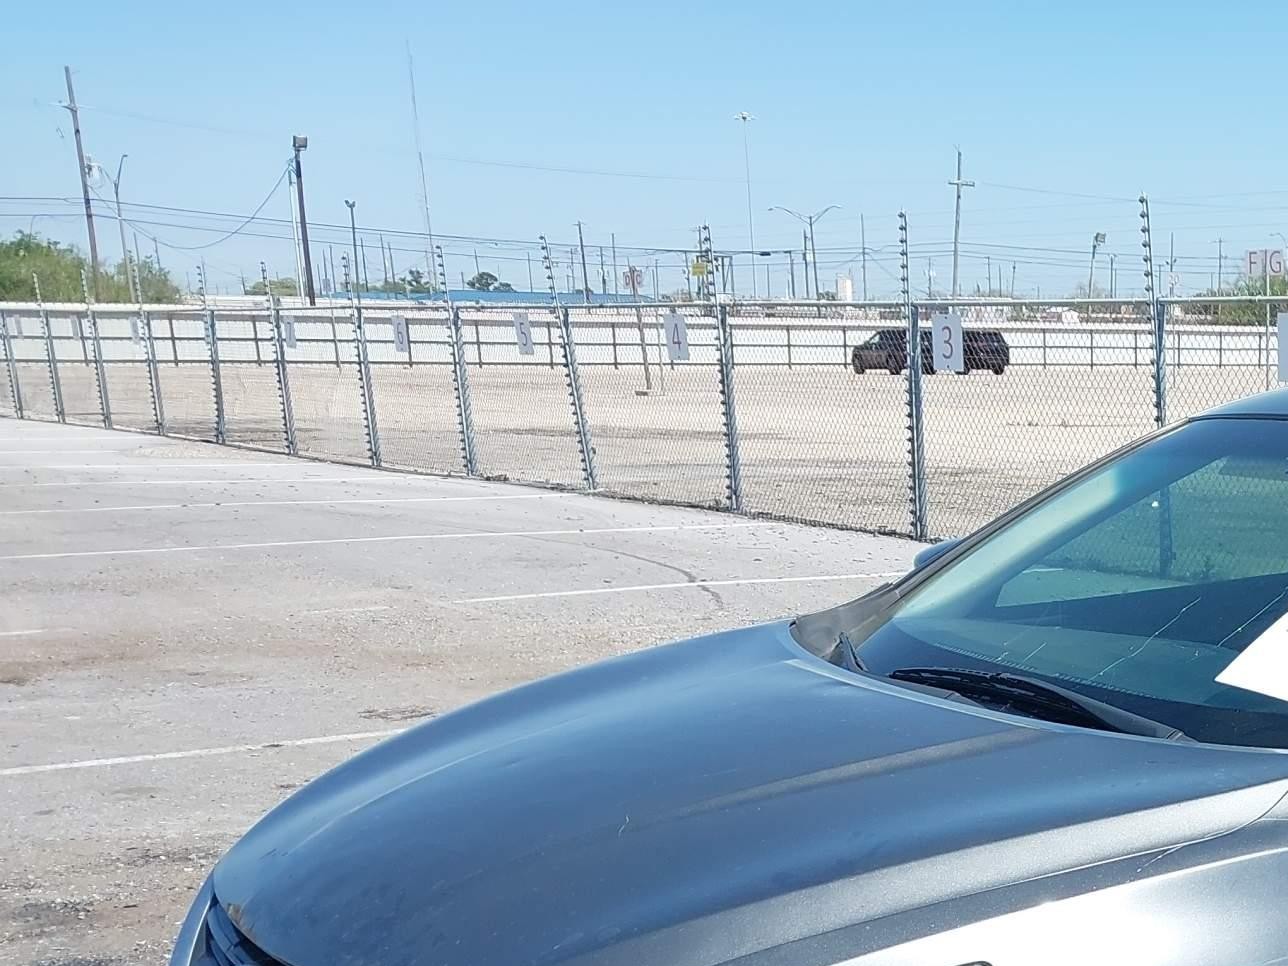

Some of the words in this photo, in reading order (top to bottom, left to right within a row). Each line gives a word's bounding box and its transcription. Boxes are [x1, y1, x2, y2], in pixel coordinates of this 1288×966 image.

[396, 322, 405, 345] 6
[519, 323, 528, 347] 5
[672, 323, 682, 351] 4
[942, 326, 954, 359] 3
